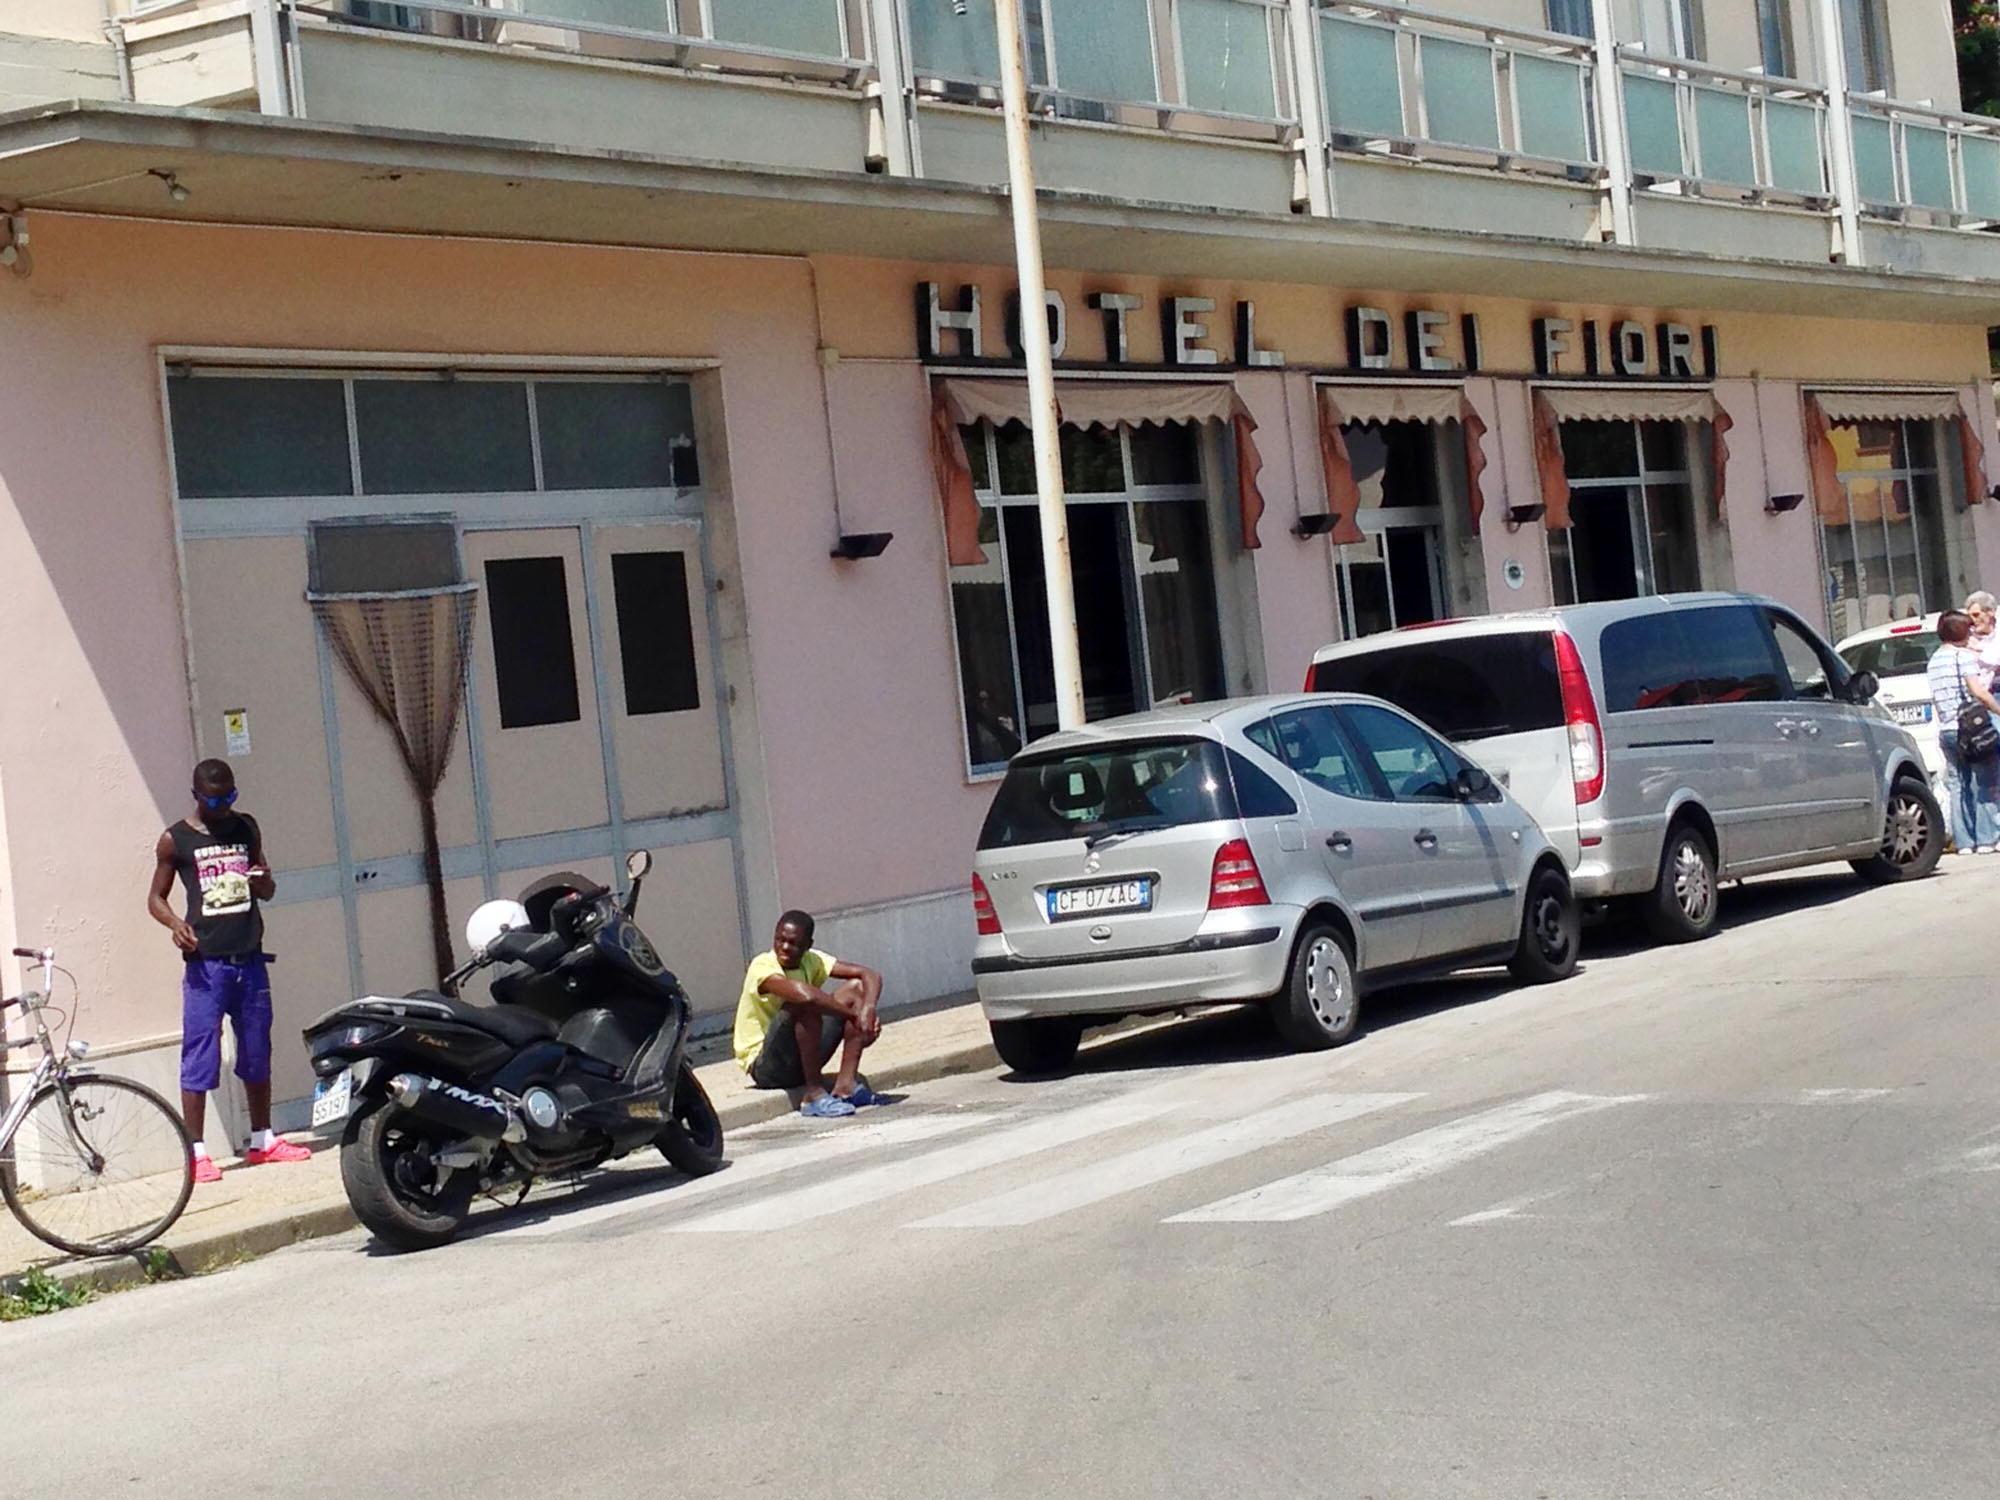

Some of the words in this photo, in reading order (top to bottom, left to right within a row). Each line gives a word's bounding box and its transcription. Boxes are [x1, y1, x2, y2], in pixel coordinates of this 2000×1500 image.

[1347, 306, 1484, 371] DEI
[1533, 317, 1721, 378] FIORI
[1059, 890, 1080, 910] CF
